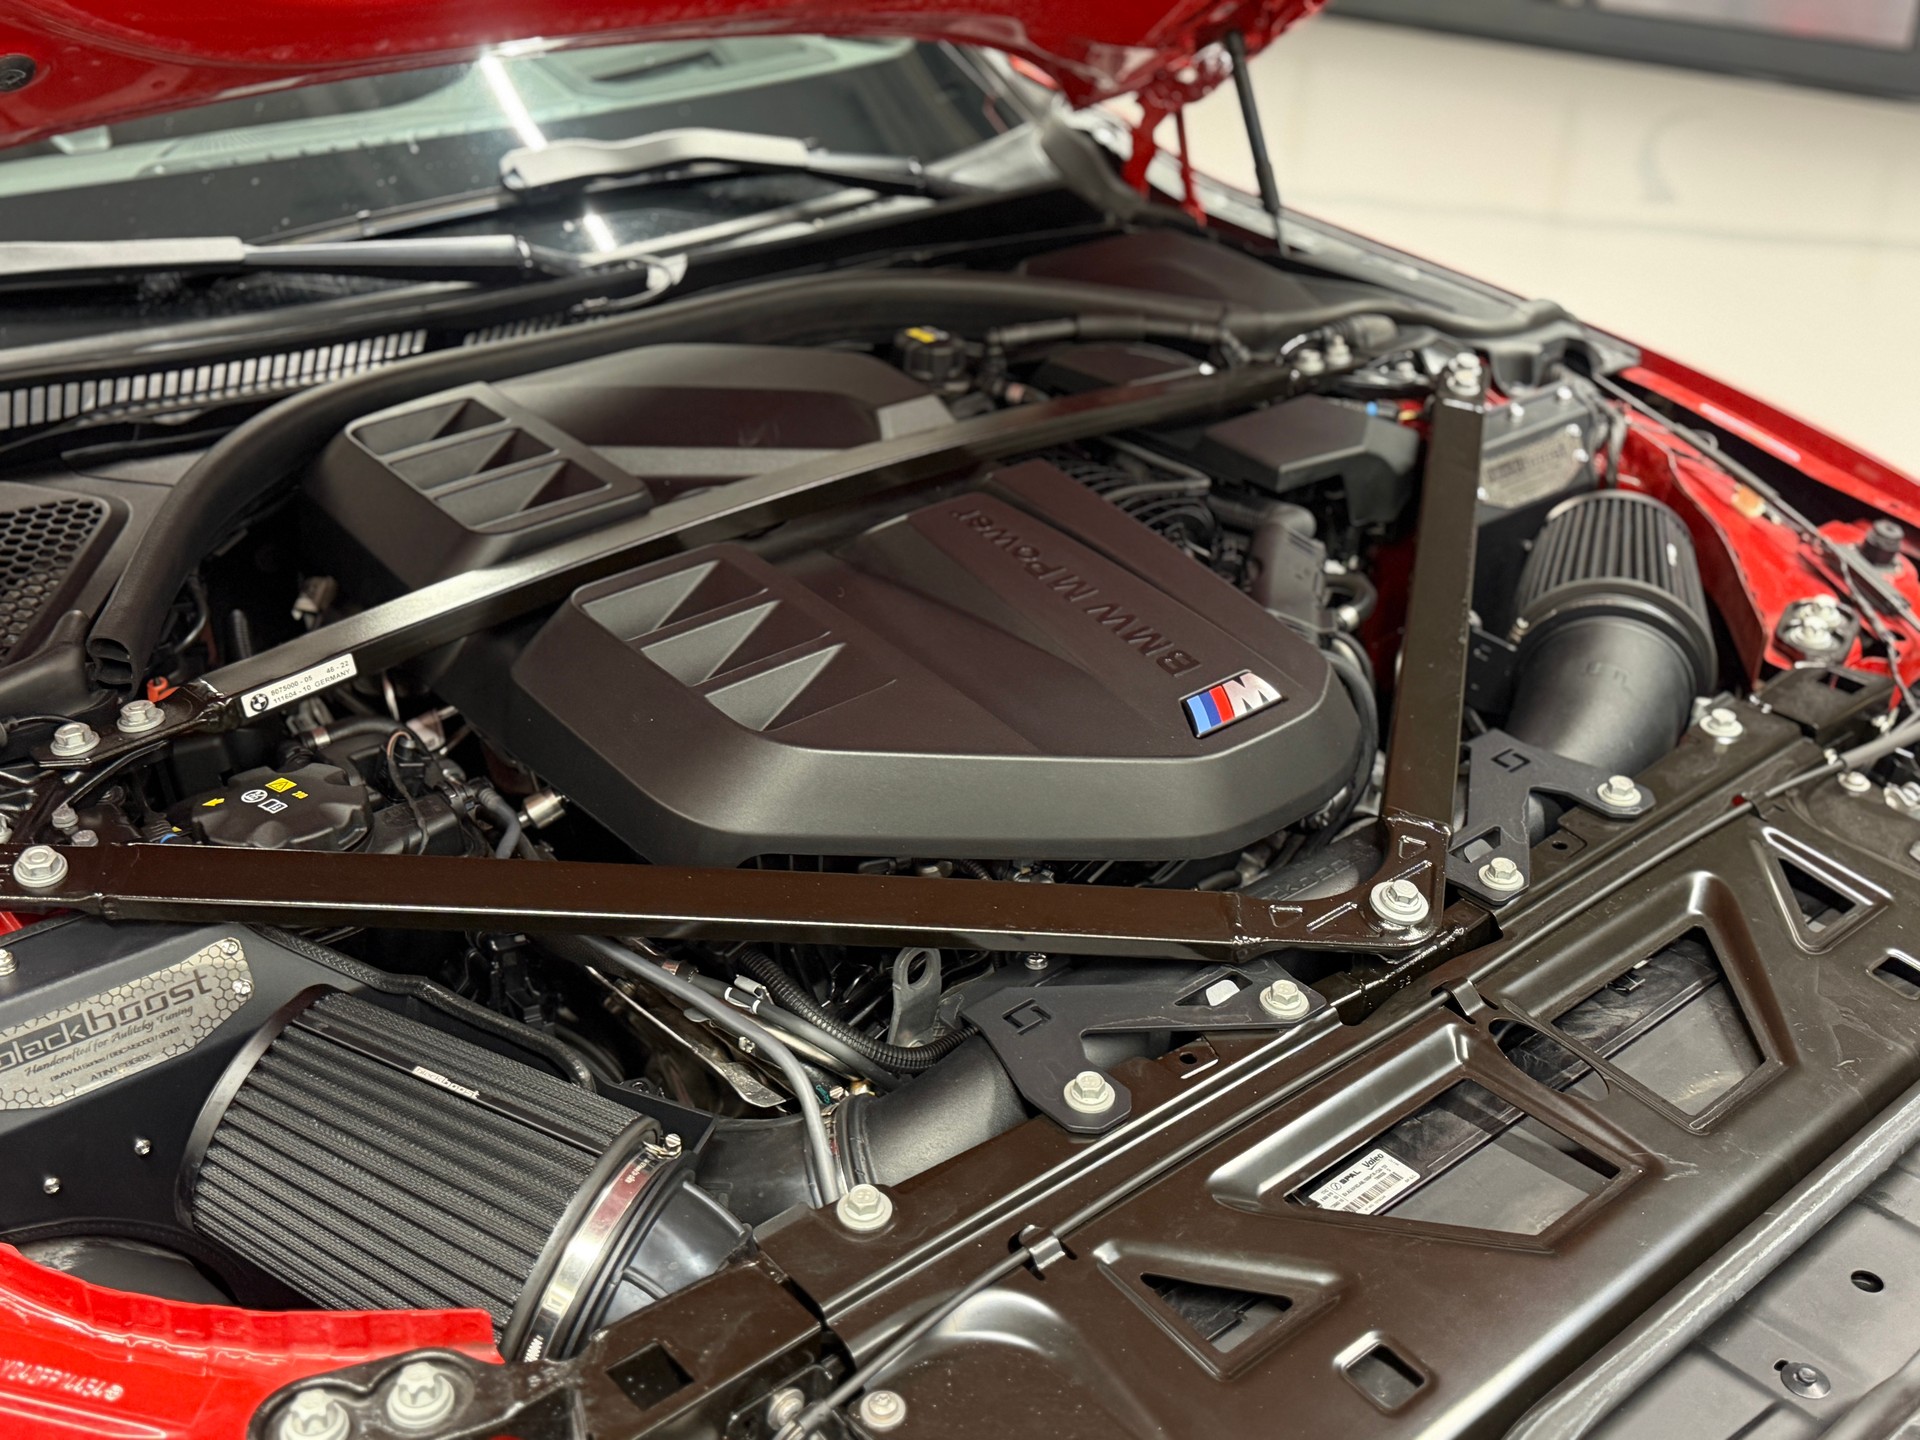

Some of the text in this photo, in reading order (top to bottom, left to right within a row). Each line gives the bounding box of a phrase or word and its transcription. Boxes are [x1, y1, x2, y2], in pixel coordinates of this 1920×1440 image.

[1084, 603, 1201, 679] BMW
[314, 668, 351, 688] GERMANY
[24, 1005, 194, 1076] Handcrafted for Aulitzky Tuning
[50, 1067, 74, 1082] BMW
[83, 1056, 105, 1072] Series
[412, 1066, 480, 1099] blackboost
[1361, 1153, 1385, 1169] Valeo
